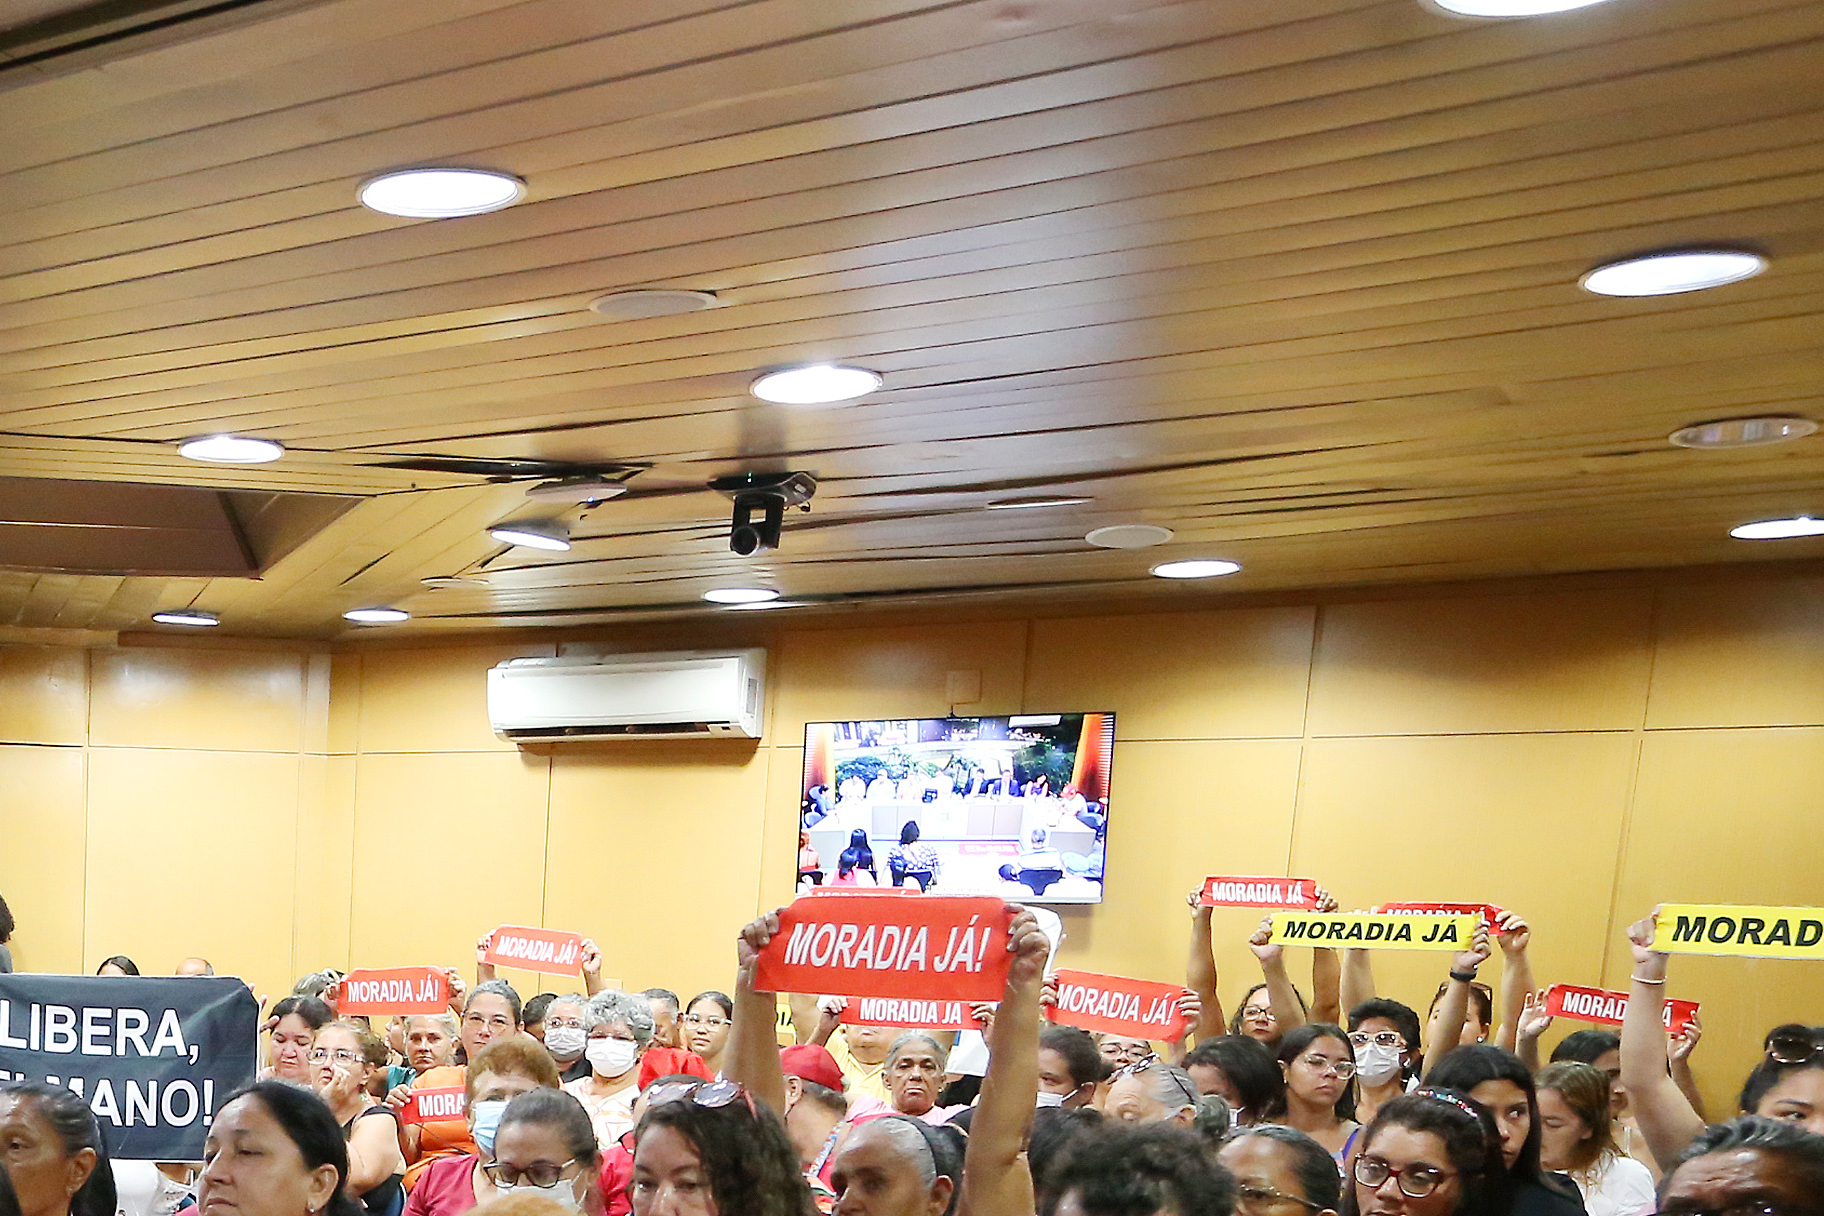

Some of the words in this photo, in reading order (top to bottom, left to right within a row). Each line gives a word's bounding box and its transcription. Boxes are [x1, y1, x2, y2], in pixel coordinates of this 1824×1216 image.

[1212, 881, 1283, 904] MORADIA
[1286, 880, 1305, 905] JÁ
[783, 922, 929, 972] MORADIA
[933, 914, 992, 973] JÁ!
[1283, 921, 1412, 942] MORADIA
[1421, 919, 1458, 943] JÁ
[1672, 915, 1824, 947] MORAD
[496, 935, 555, 963] MORADIA
[554, 939, 578, 965] JÁ!
[347, 979, 414, 1003] MORADIA
[416, 974, 440, 1002] JÁ!
[859, 998, 940, 1024] MORADIA
[1056, 983, 1141, 1021] MORADIA
[1142, 992, 1177, 1026] JÁ!
